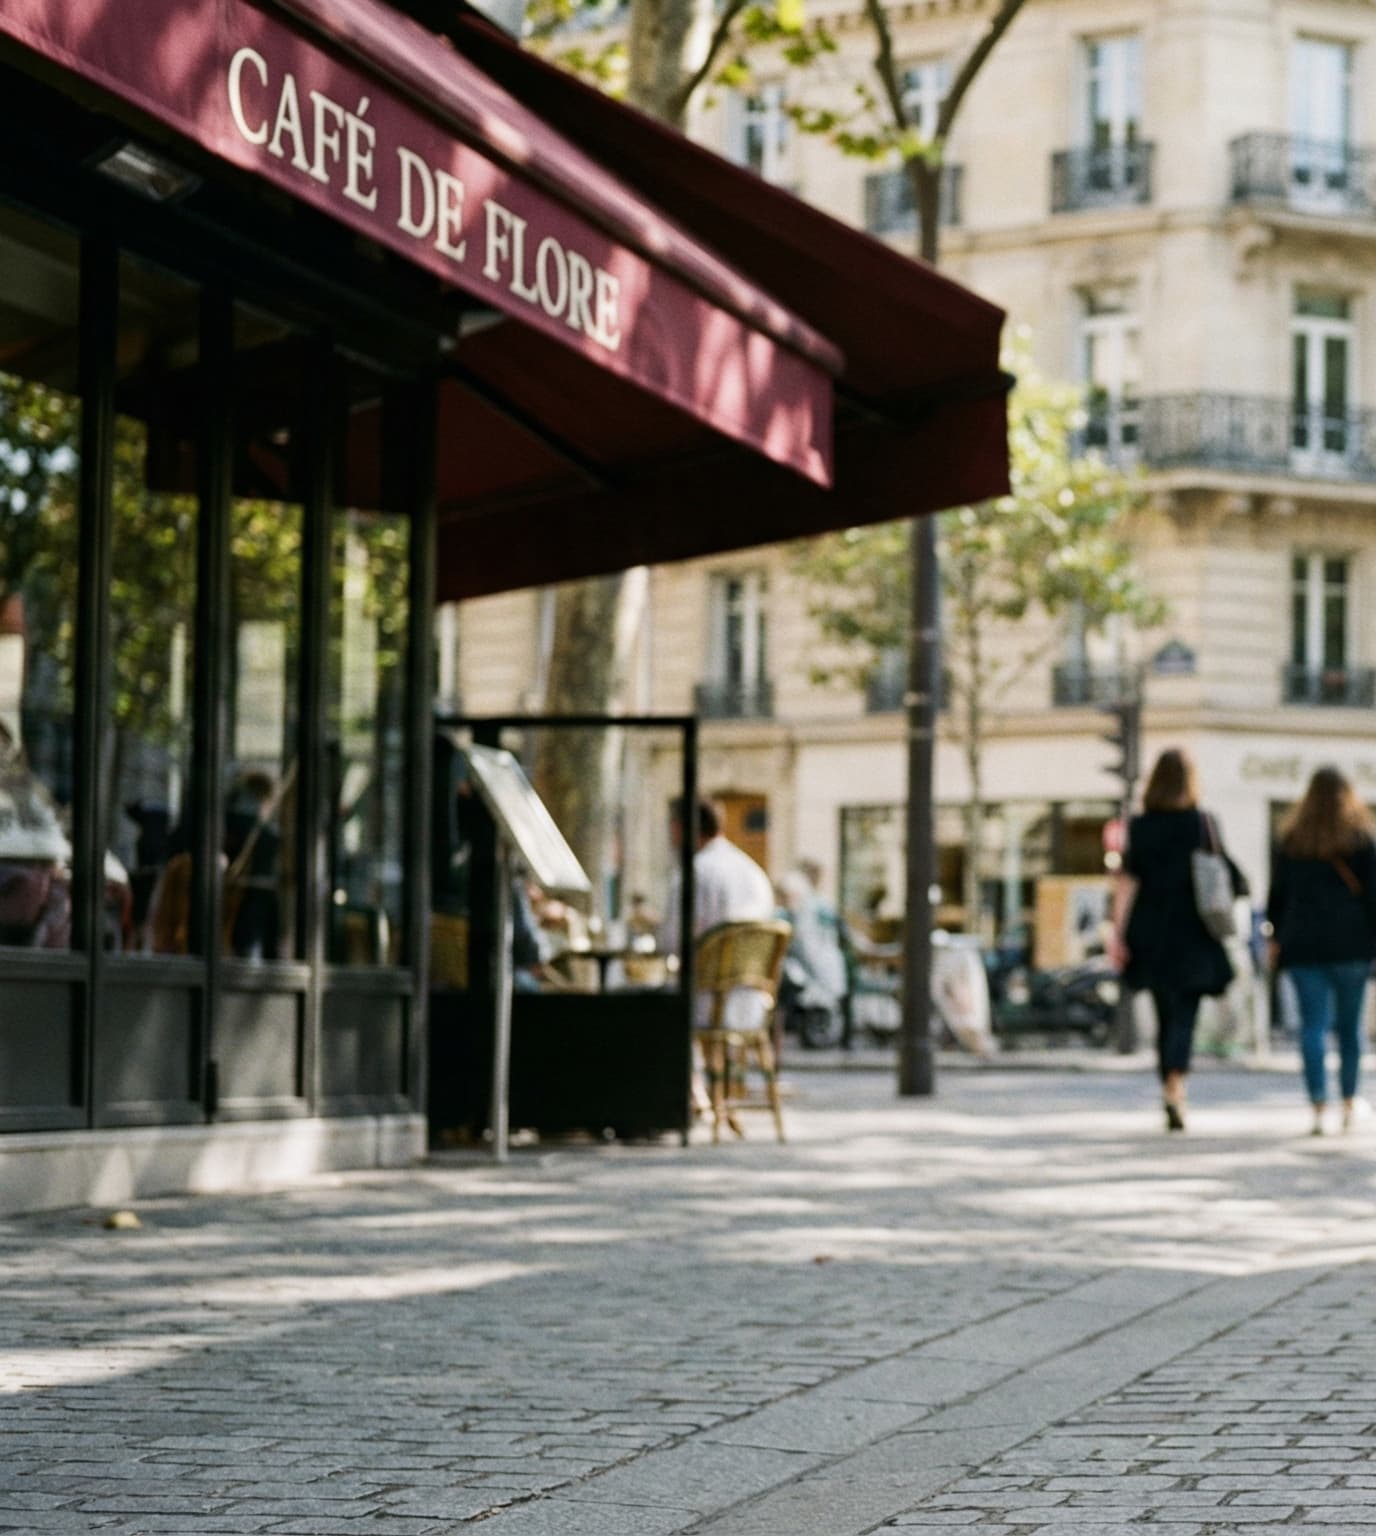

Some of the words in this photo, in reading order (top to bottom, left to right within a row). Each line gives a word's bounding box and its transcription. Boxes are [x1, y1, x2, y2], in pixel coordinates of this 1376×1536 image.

[228, 47, 378, 212] CAFÉ
[397, 146, 467, 262] DE
[483, 199, 621, 352] FLORE
